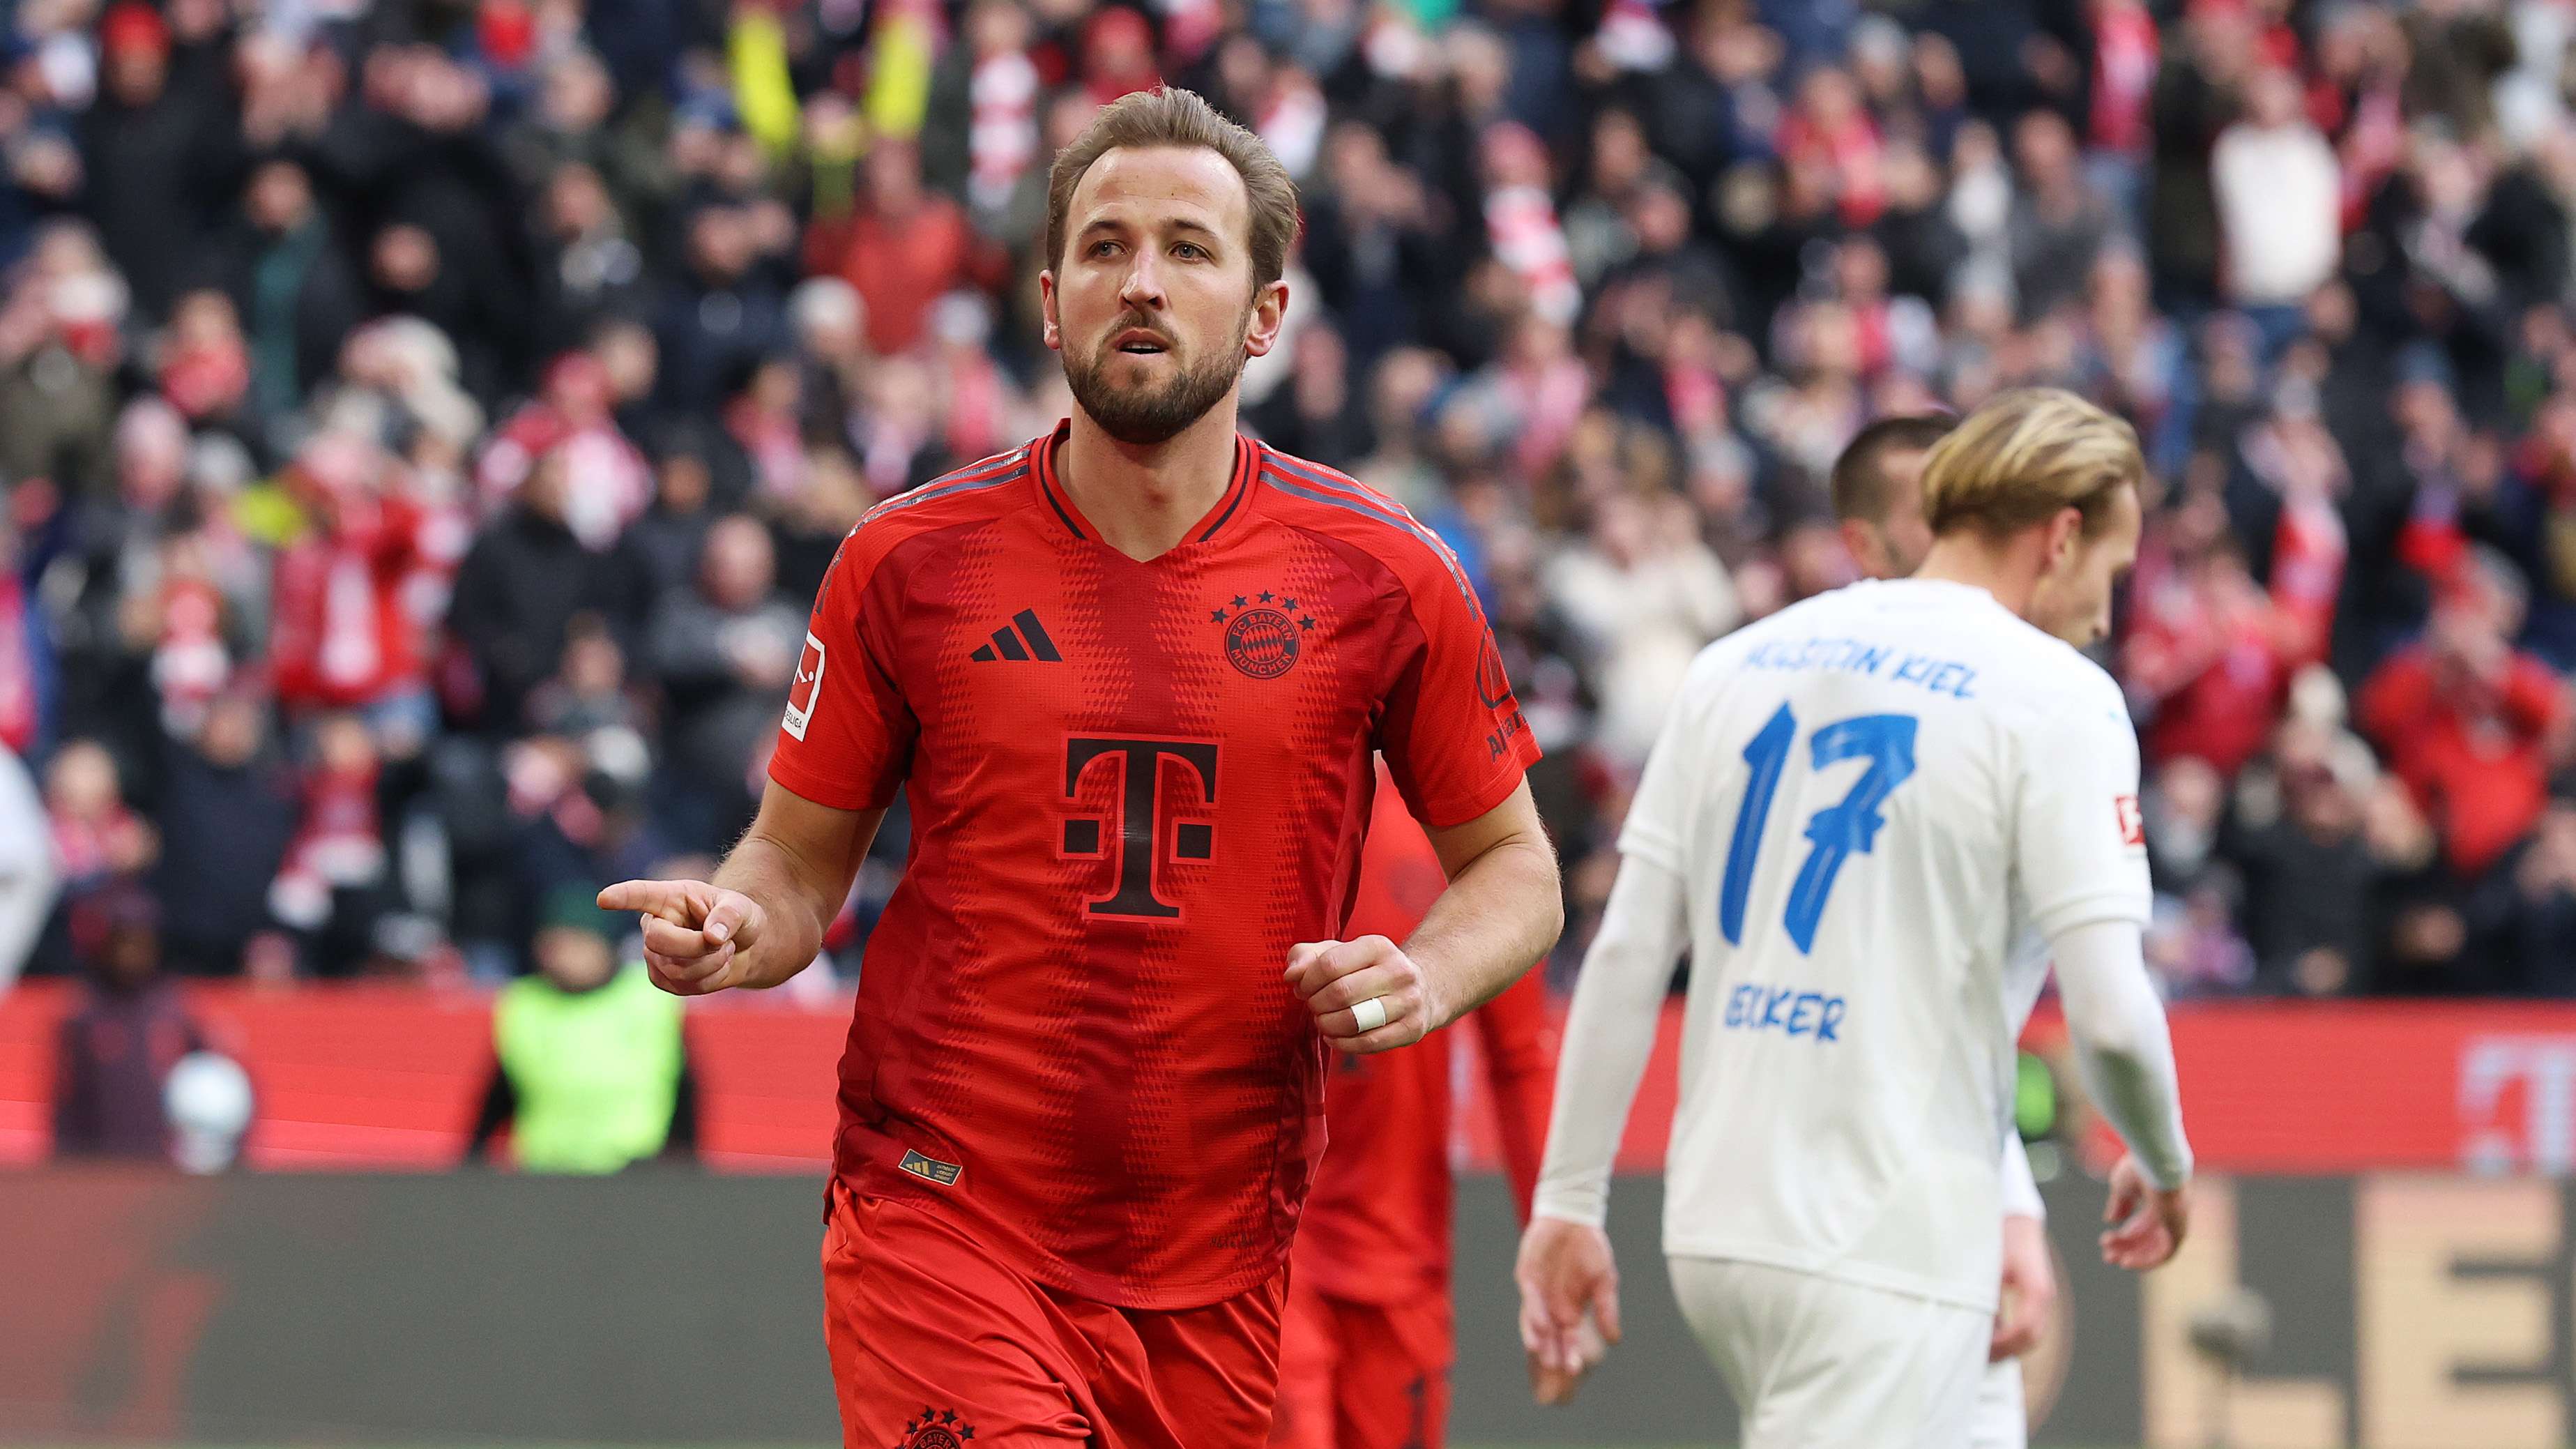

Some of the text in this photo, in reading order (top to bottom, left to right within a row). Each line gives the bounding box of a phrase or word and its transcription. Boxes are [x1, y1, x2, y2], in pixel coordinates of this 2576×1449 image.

[1232, 613, 1296, 641] FC BAYERN
[1891, 654, 1978, 698] KIEL
[1062, 737, 1219, 919] T
[1719, 699, 1919, 955] 17
